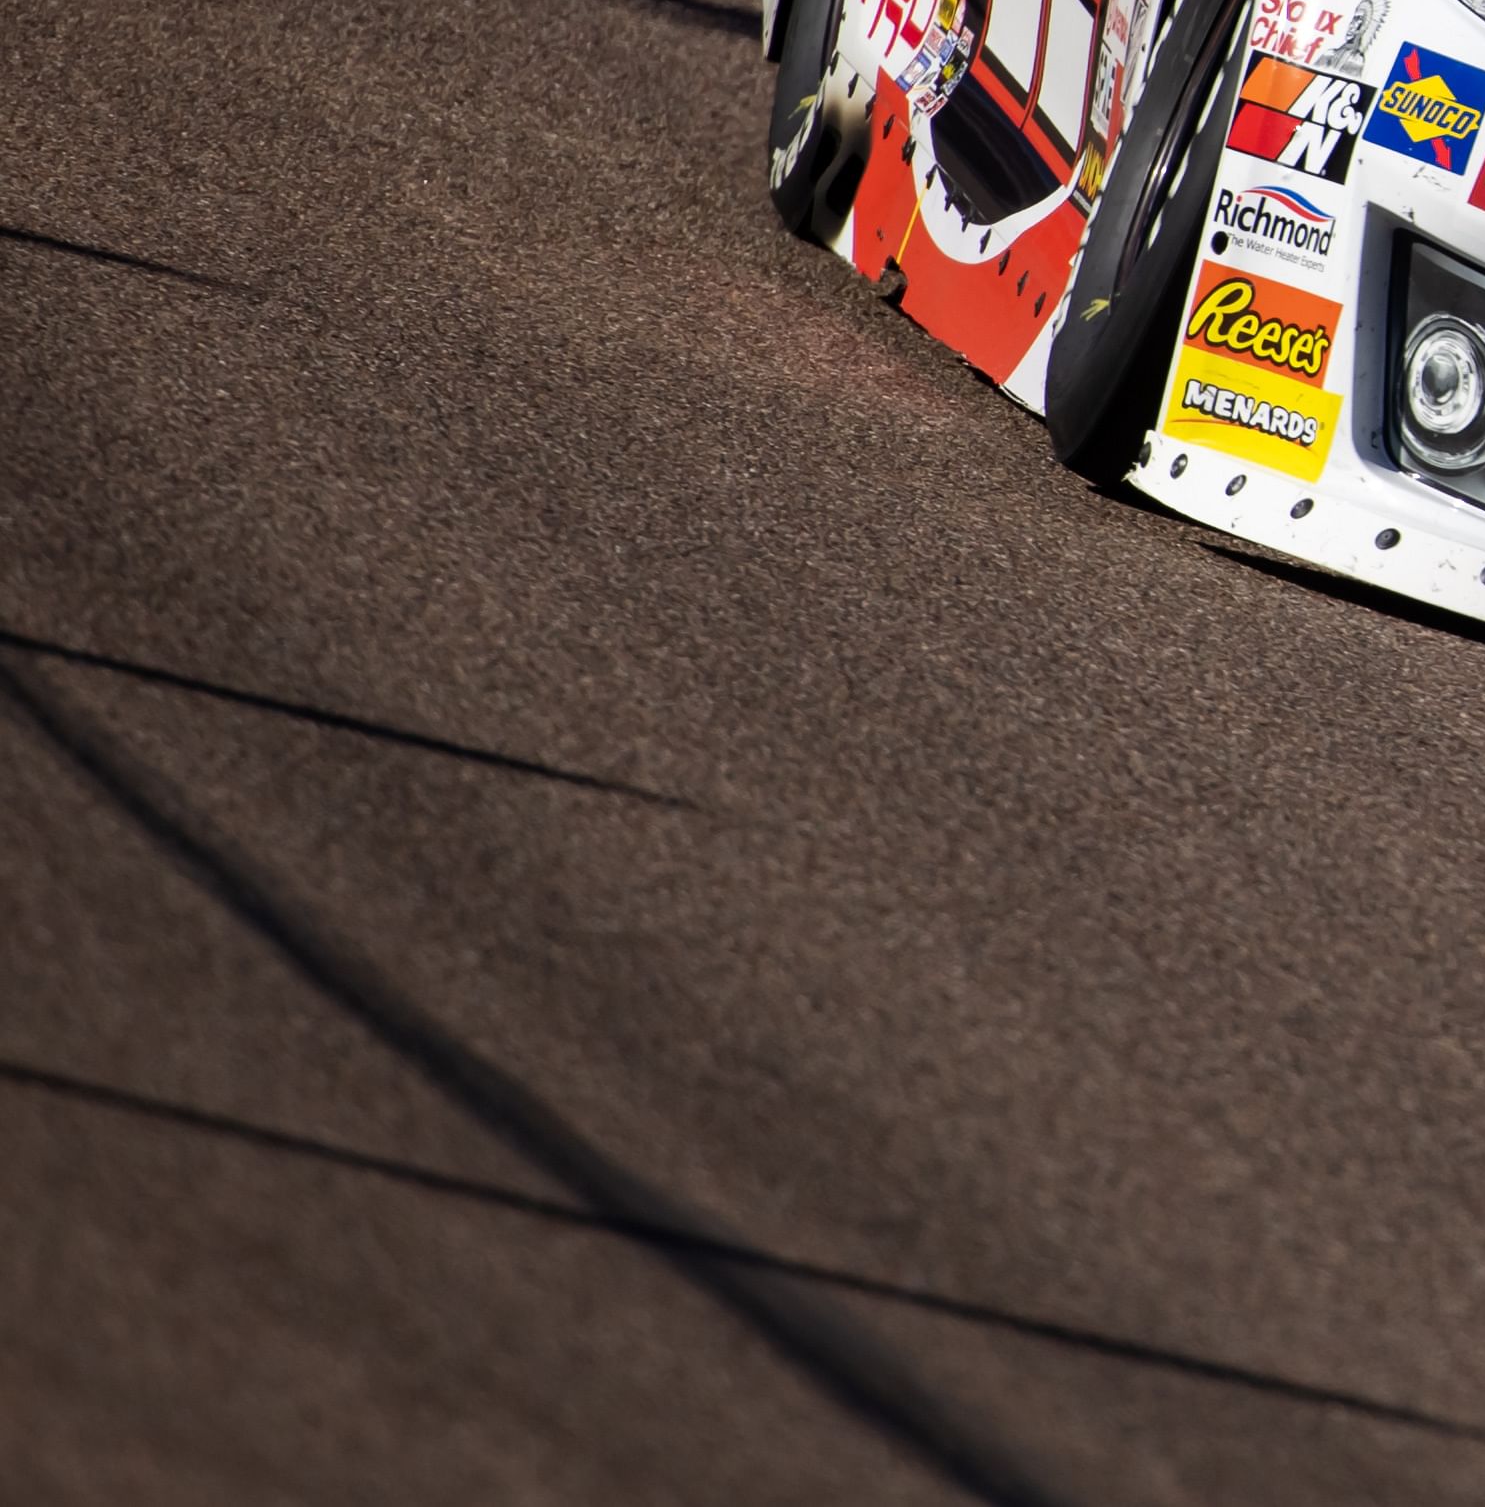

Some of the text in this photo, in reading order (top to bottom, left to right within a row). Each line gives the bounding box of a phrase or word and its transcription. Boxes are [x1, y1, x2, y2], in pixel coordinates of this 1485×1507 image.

[1383, 86, 1476, 136] SUNOCO
[1213, 188, 1336, 257] Richmond
[1246, 236, 1274, 256] Water
[1274, 246, 1300, 266] Heater
[1300, 252, 1326, 273] Experts
[1186, 278, 1330, 377] Reese's
[1183, 379, 1318, 447] MENARDS
